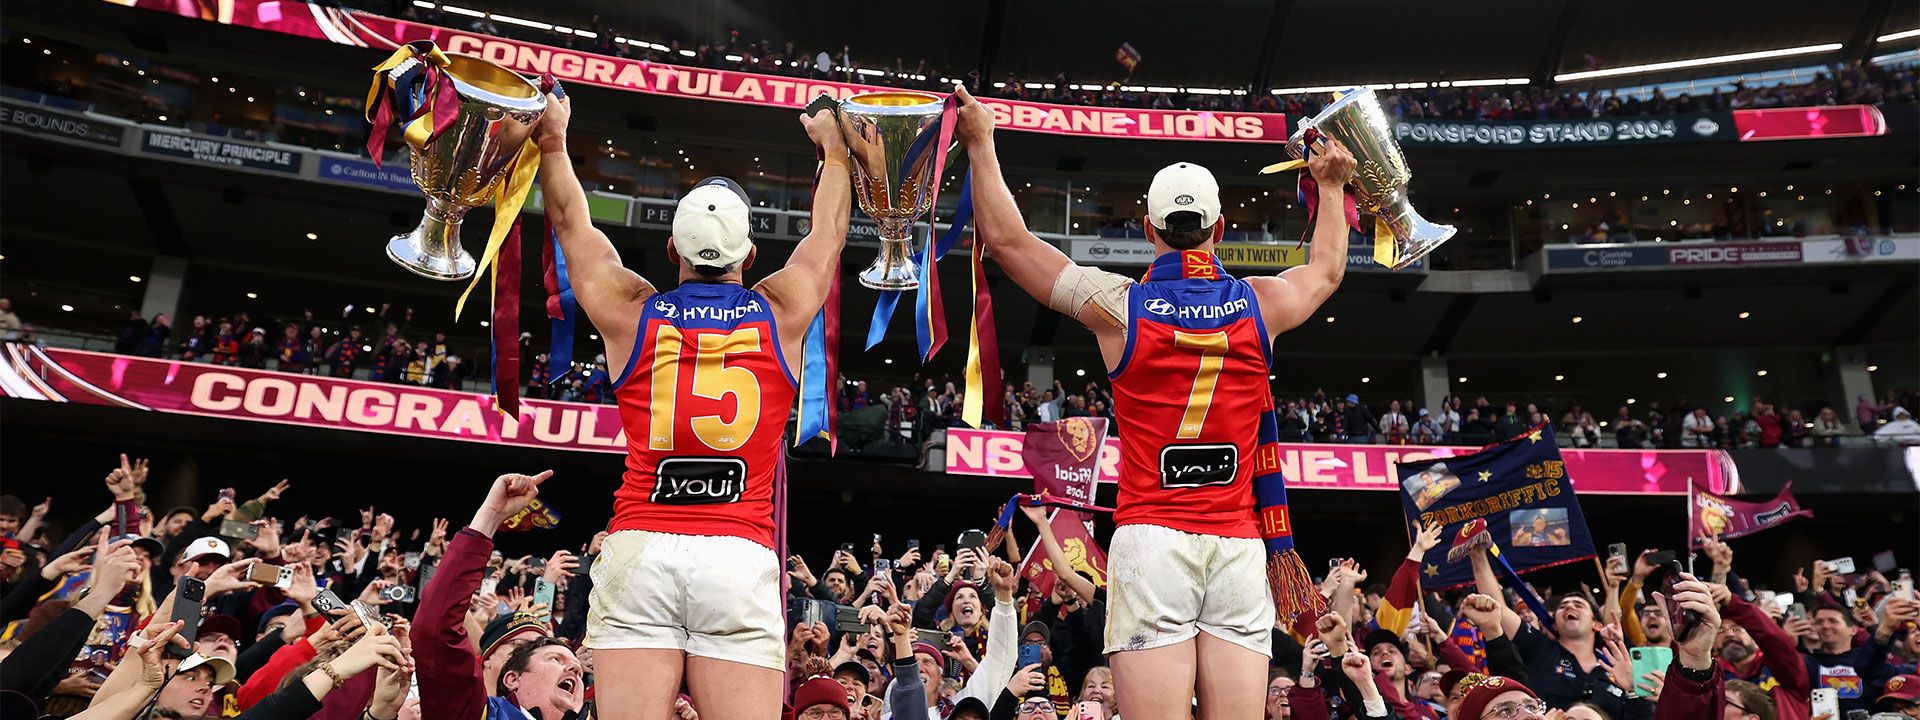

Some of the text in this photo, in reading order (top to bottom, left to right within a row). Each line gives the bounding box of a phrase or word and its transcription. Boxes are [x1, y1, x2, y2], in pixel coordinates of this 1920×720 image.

[448, 34, 1264, 139] CONGRATULATIO SBANE LIONS
[13, 110, 89, 137] BOUNDS
[1396, 121, 1526, 145] PONSFORD
[1528, 121, 1614, 144] STAND
[1616, 119, 1677, 141] 2004
[149, 132, 291, 166] MERCURY PRINCIPLE
[343, 165, 376, 180] Carlton
[1246, 248, 1288, 264] TWENTY
[1670, 247, 1740, 262] PRIDE
[648, 324, 761, 451] 15
[1173, 330, 1228, 439] 7
[1526, 460, 1564, 479] #15
[665, 470, 733, 498] youi
[1421, 479, 1561, 530] ZORKORIFFIC
